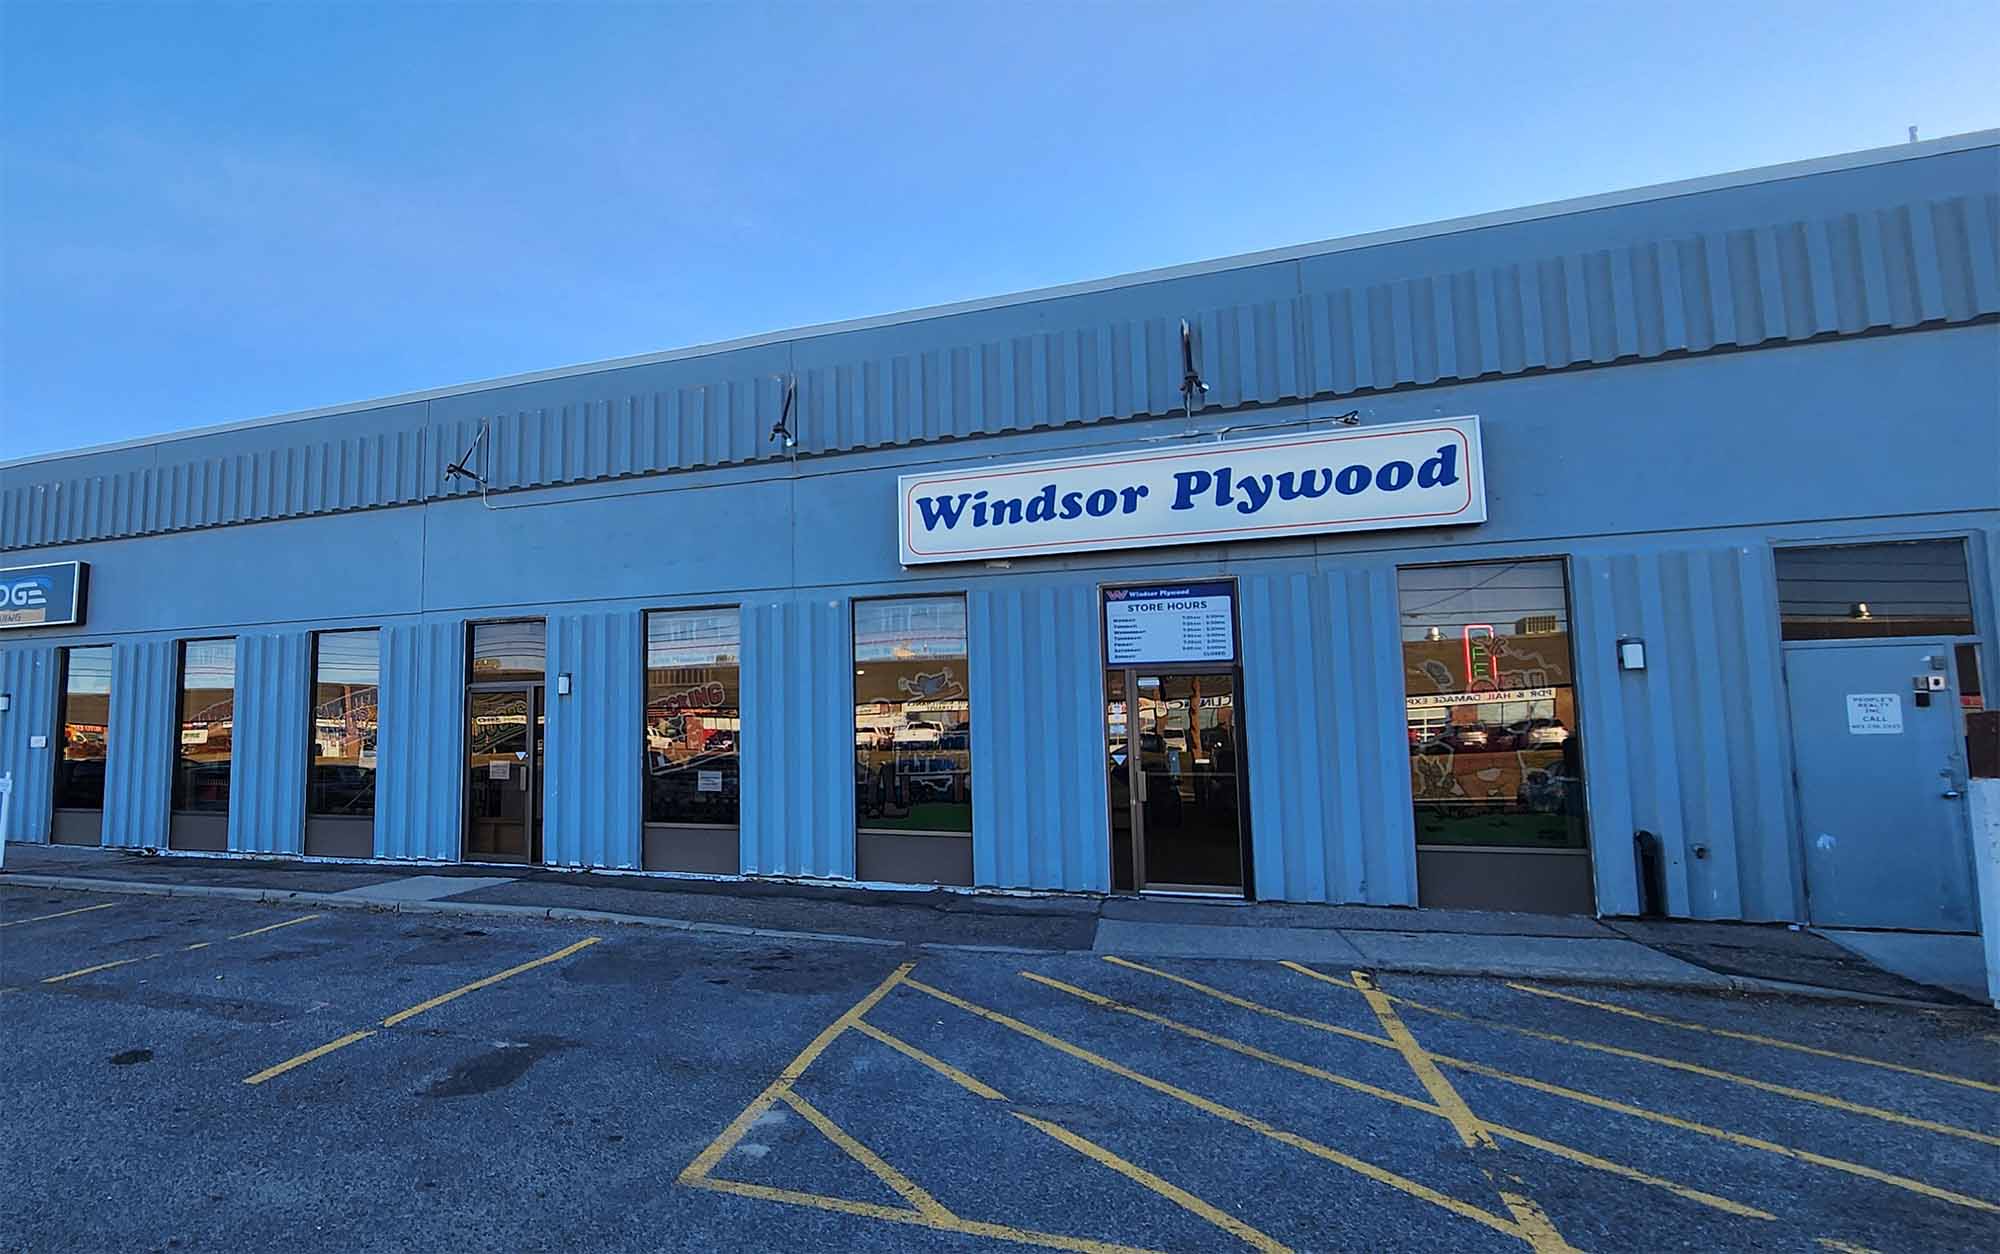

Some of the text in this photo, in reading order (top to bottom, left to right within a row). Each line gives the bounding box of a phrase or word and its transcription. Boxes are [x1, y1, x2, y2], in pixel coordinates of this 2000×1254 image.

[916, 444, 1460, 531] Windsor Plywood
[1127, 600, 1208, 613] STORE HOURS
